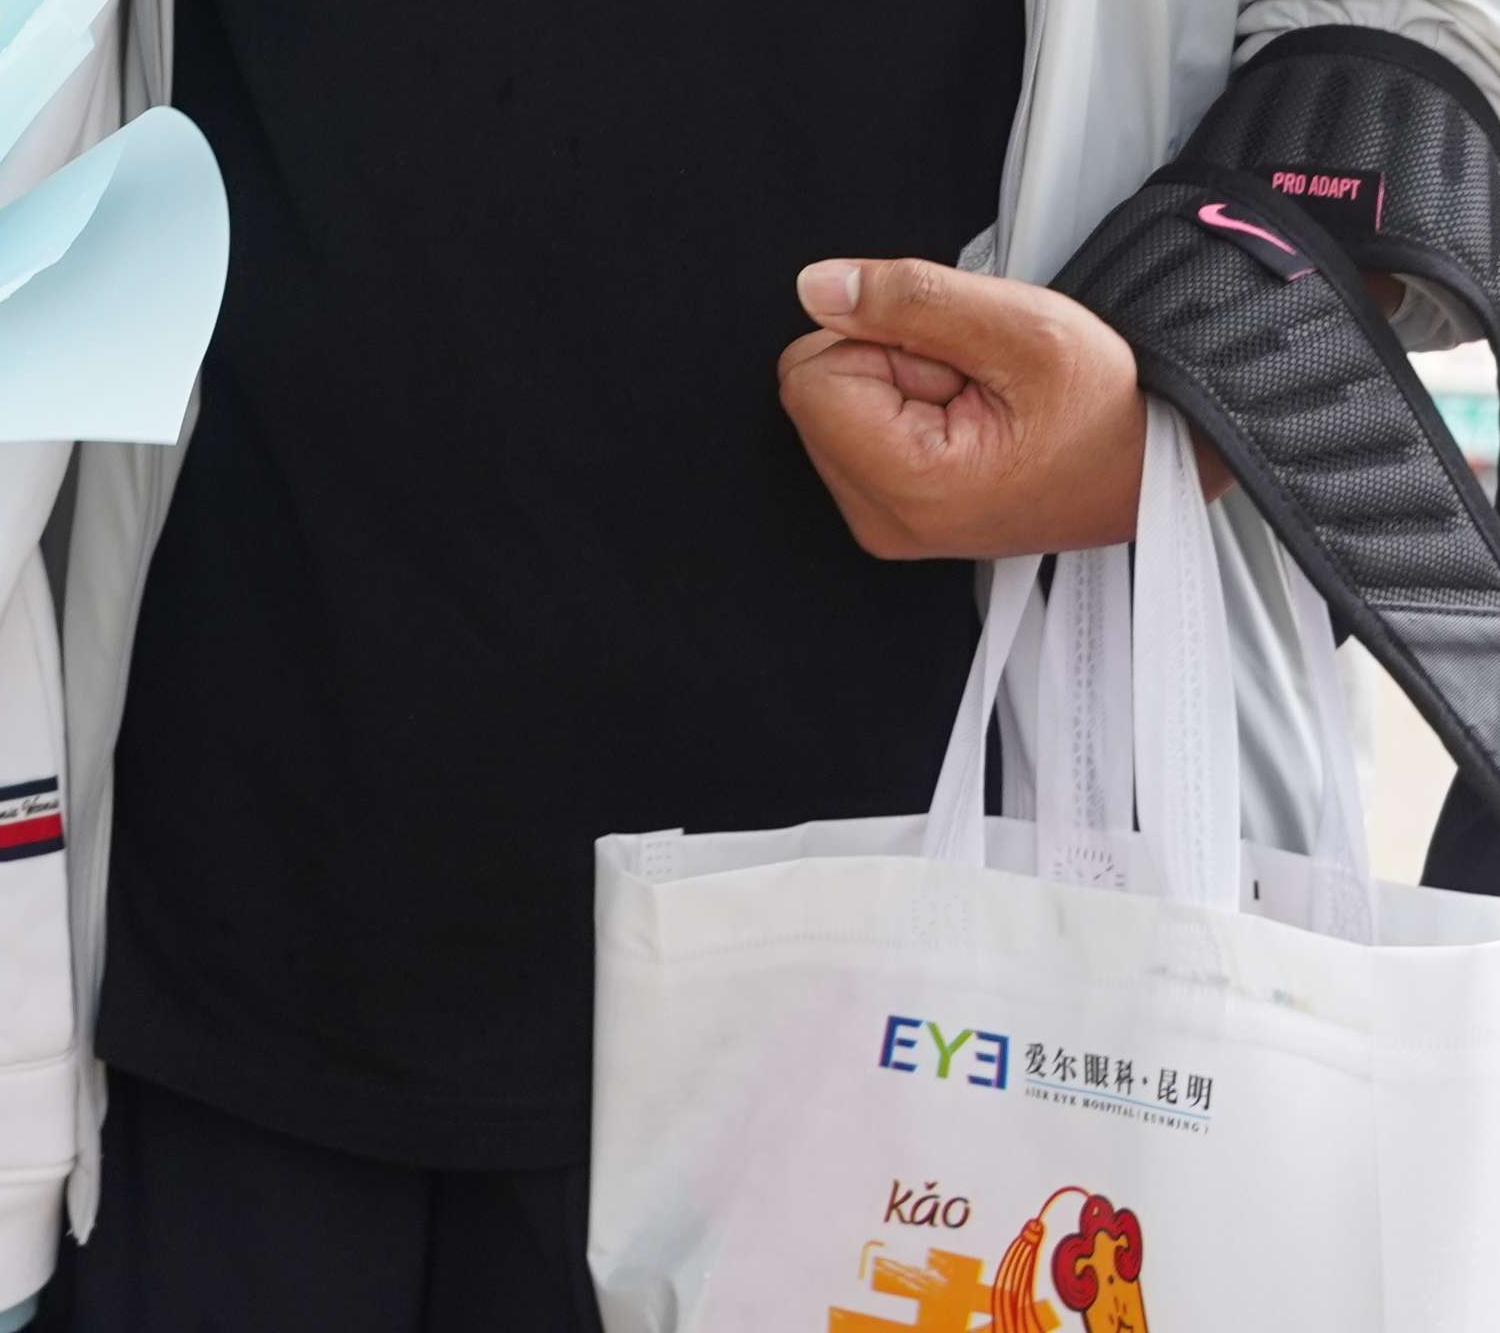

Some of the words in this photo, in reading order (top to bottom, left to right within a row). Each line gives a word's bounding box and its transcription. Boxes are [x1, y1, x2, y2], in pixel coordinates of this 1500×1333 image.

[1272, 171, 1306, 195] PRO
[1307, 174, 1362, 201] ADAPT
[1052, 1092, 1078, 1107] EYE
[883, 1178, 972, 1230] kǎo
